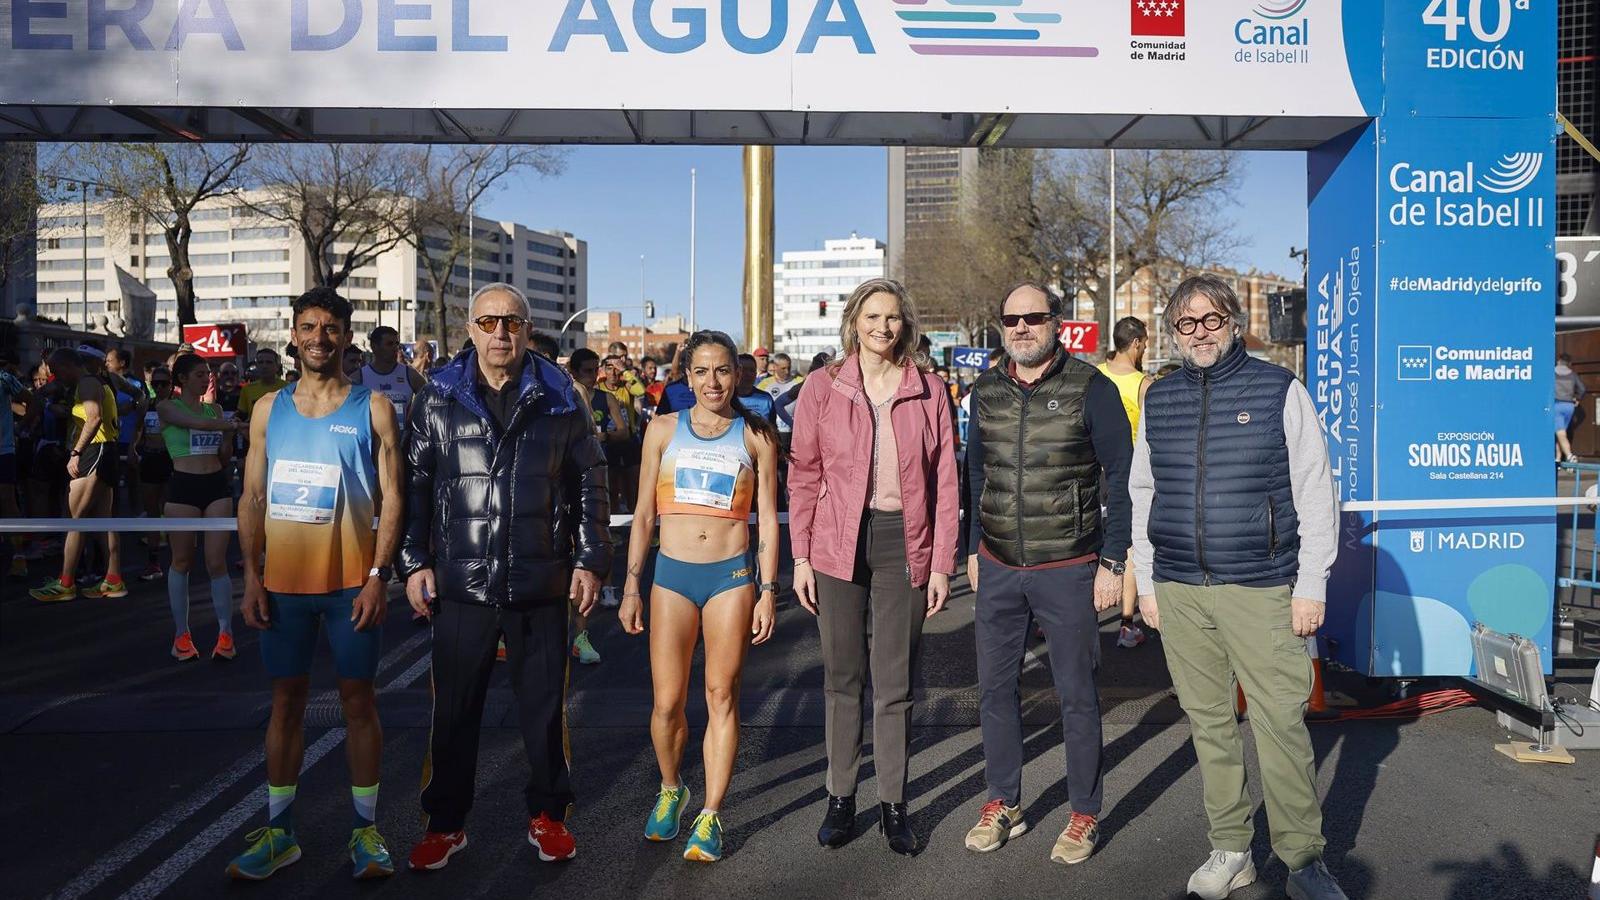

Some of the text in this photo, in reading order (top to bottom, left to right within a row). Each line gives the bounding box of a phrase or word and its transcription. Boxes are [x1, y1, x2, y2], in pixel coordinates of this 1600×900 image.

[290, 0, 509, 52] DEL
[546, 0, 877, 54] AGUA
[1234, 18, 1308, 46] Canal
[1130, 41, 1186, 50] Comunidad
[1130, 52, 1186, 61] de Madrid
[1234, 49, 1308, 63] de Isabel II
[1426, 45, 1524, 70] EDICIÓN
[1389, 162, 1473, 193] Canal
[1389, 197, 1543, 227] de Isabel II
[1348, 246, 1361, 316] Ojeda
[1389, 276, 1542, 295] #deMadridydelgrifo
[1317, 272, 1330, 446] ARRERA
[1347, 323, 1360, 376] Juan
[1435, 346, 1533, 361] Comunidad
[1435, 365, 1532, 380] de Madrid
[1330, 330, 1343, 444] AGUA
[1346, 381, 1360, 431] José
[329, 424, 358, 435] HOKA
[1437, 431, 1494, 441] EXPOSICIÓN
[1408, 443, 1523, 467] SOMOS AGUA
[700, 473, 709, 489] 1
[1429, 472, 1504, 480] Sala Castellana 214
[295, 487, 310, 504] 2
[1438, 532, 1525, 549] MADRID
